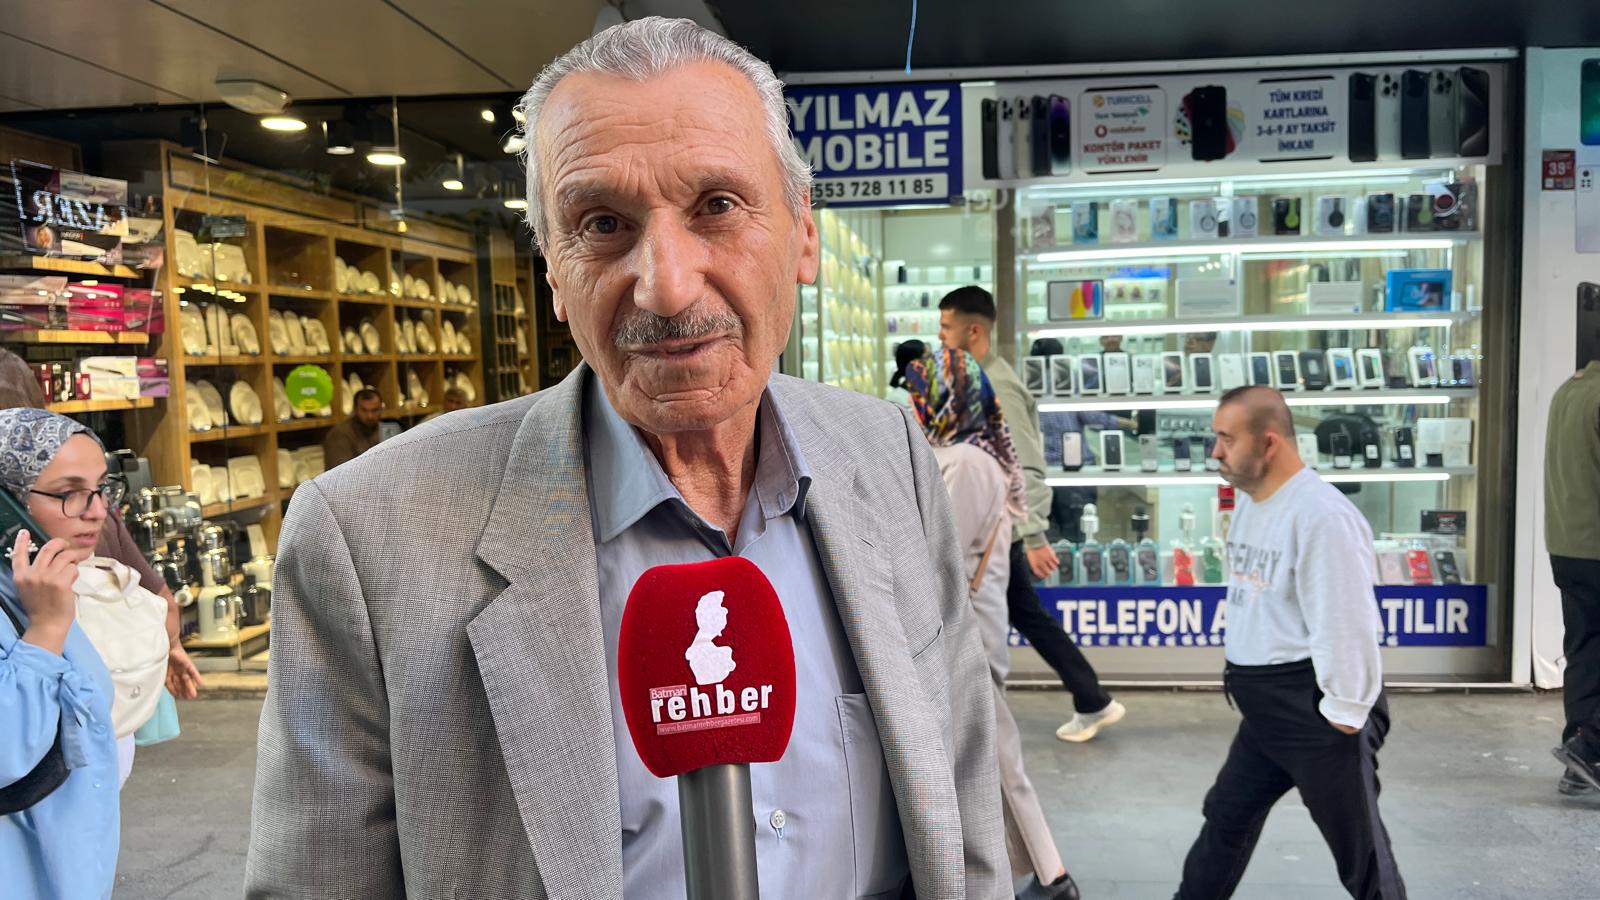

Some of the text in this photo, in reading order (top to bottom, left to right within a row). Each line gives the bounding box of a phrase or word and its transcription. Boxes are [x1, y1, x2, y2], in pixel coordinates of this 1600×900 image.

[1270, 87, 1323, 103] TÜM KREDİ
[786, 89, 950, 132] YILMAZ
[1263, 106, 1329, 120] KARTLARINA
[1256, 120, 1336, 137] 3-6-9 AY TAKSİT
[1083, 140, 1161, 153] KONTÖR PAKET
[808, 178, 934, 198] 553 728 11 85
[1056, 598, 1202, 635] TELEFON
[651, 687, 687, 700] Batman
[650, 684, 773, 722] rehber
